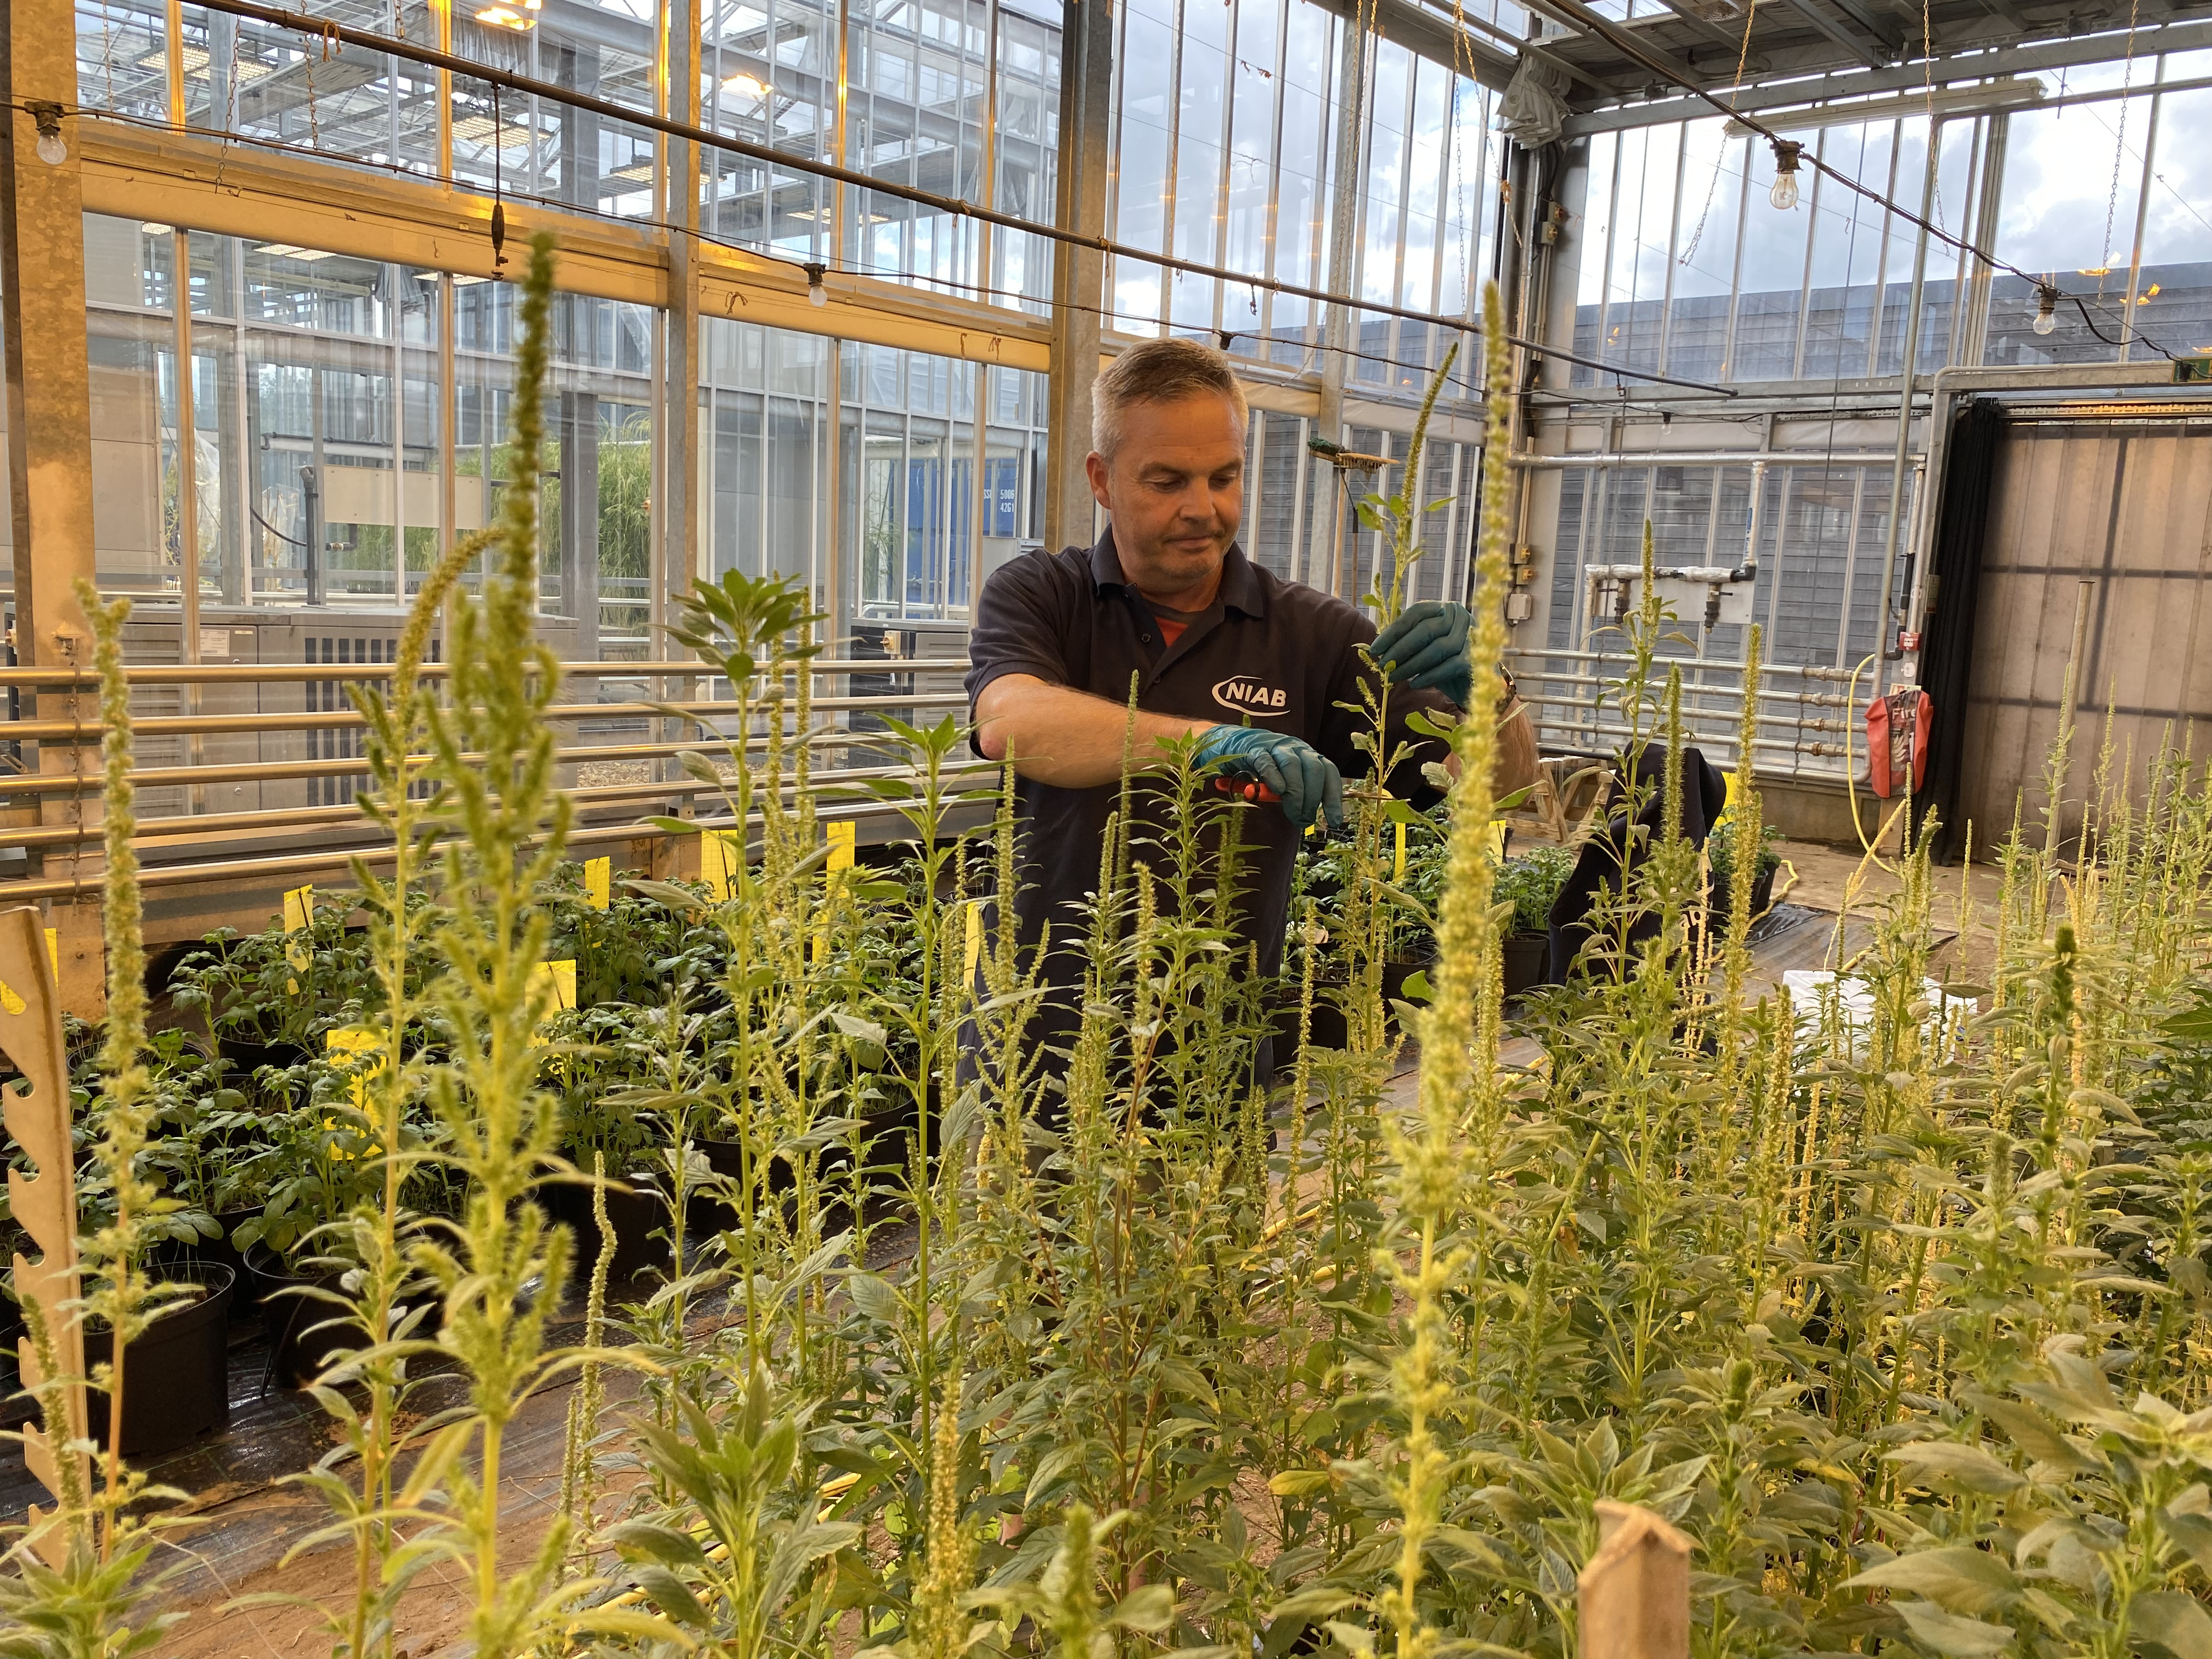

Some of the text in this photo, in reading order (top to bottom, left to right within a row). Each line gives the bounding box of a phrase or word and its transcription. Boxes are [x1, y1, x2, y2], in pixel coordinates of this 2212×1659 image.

[1000, 489, 1014, 499] 5006
[1000, 503, 1014, 512] 42G1
[1226, 682, 1286, 707] NIAB
[1892, 708, 1915, 720] Fire
